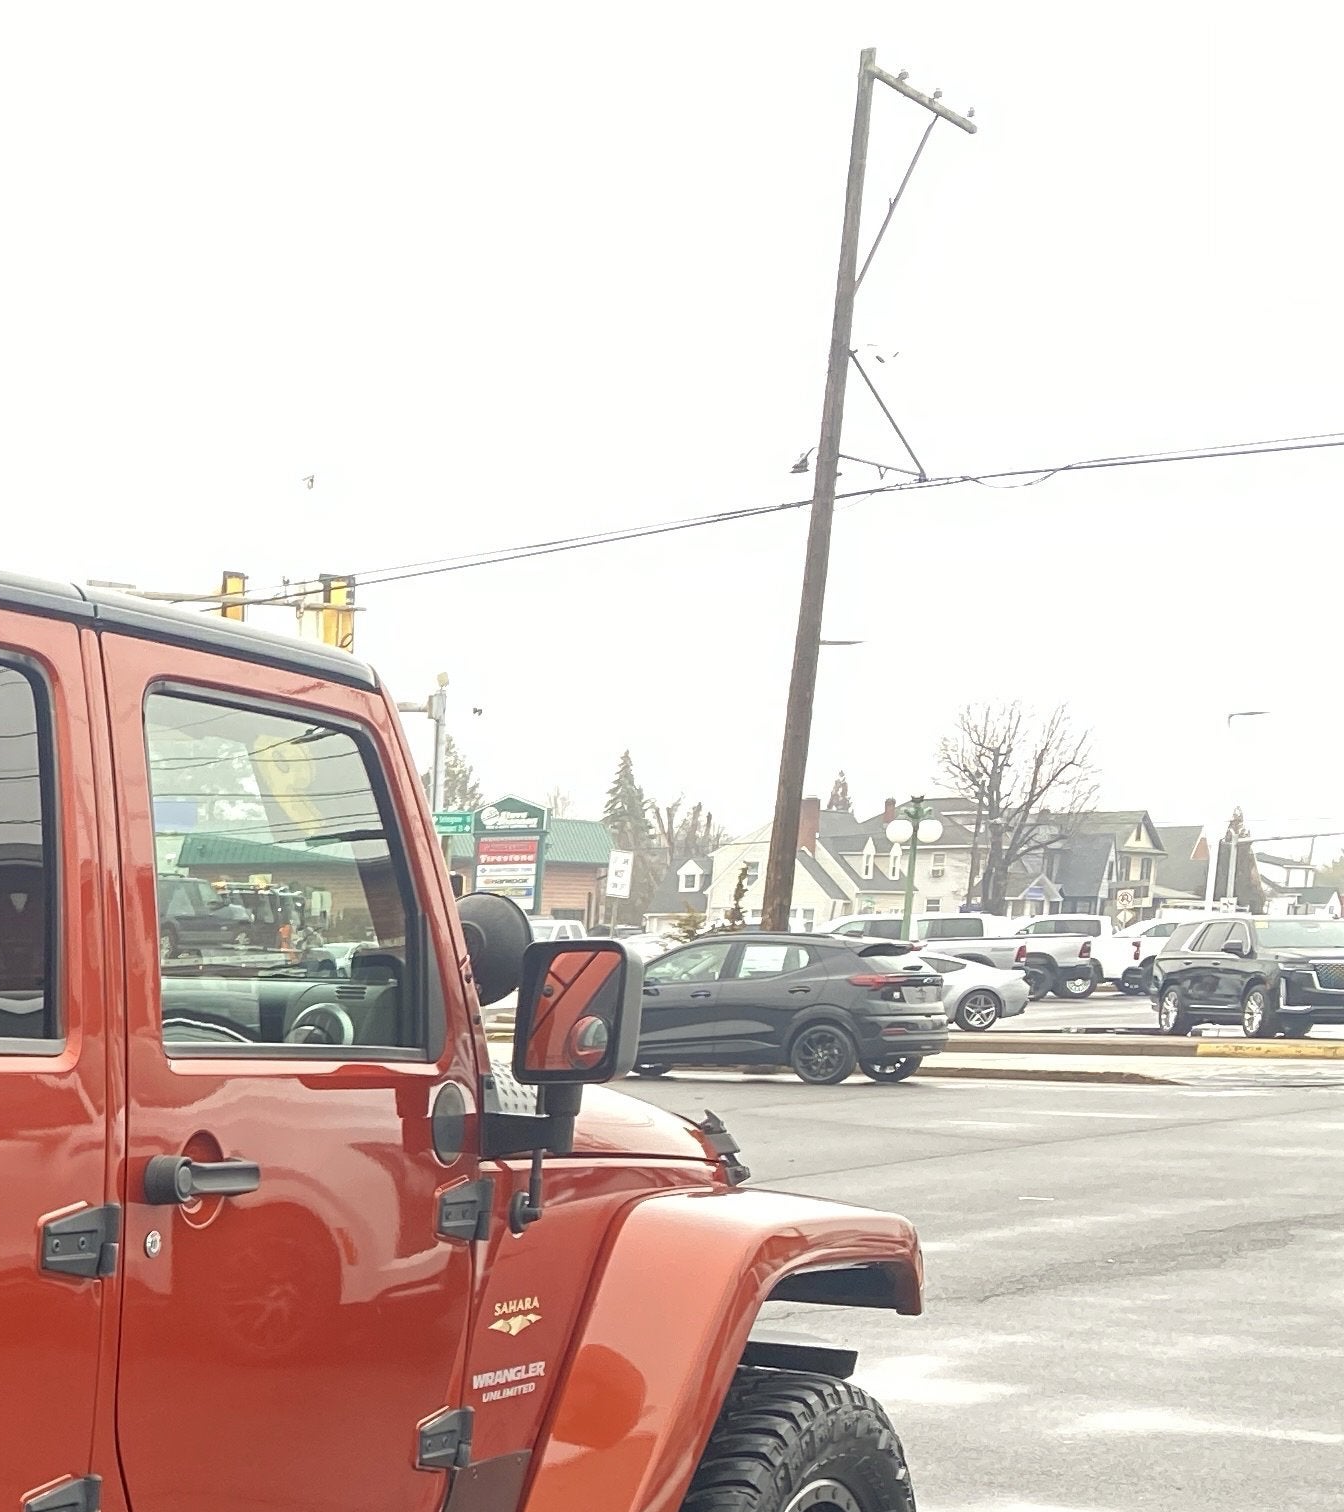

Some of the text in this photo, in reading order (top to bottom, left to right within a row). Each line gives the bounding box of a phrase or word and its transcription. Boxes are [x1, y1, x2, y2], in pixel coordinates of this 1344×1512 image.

[479, 854, 534, 864] Firestone
[494, 1296, 540, 1317] SAHARA
[472, 1361, 545, 1390] WRANGLER
[482, 1382, 536, 1403] UNLIMITED
